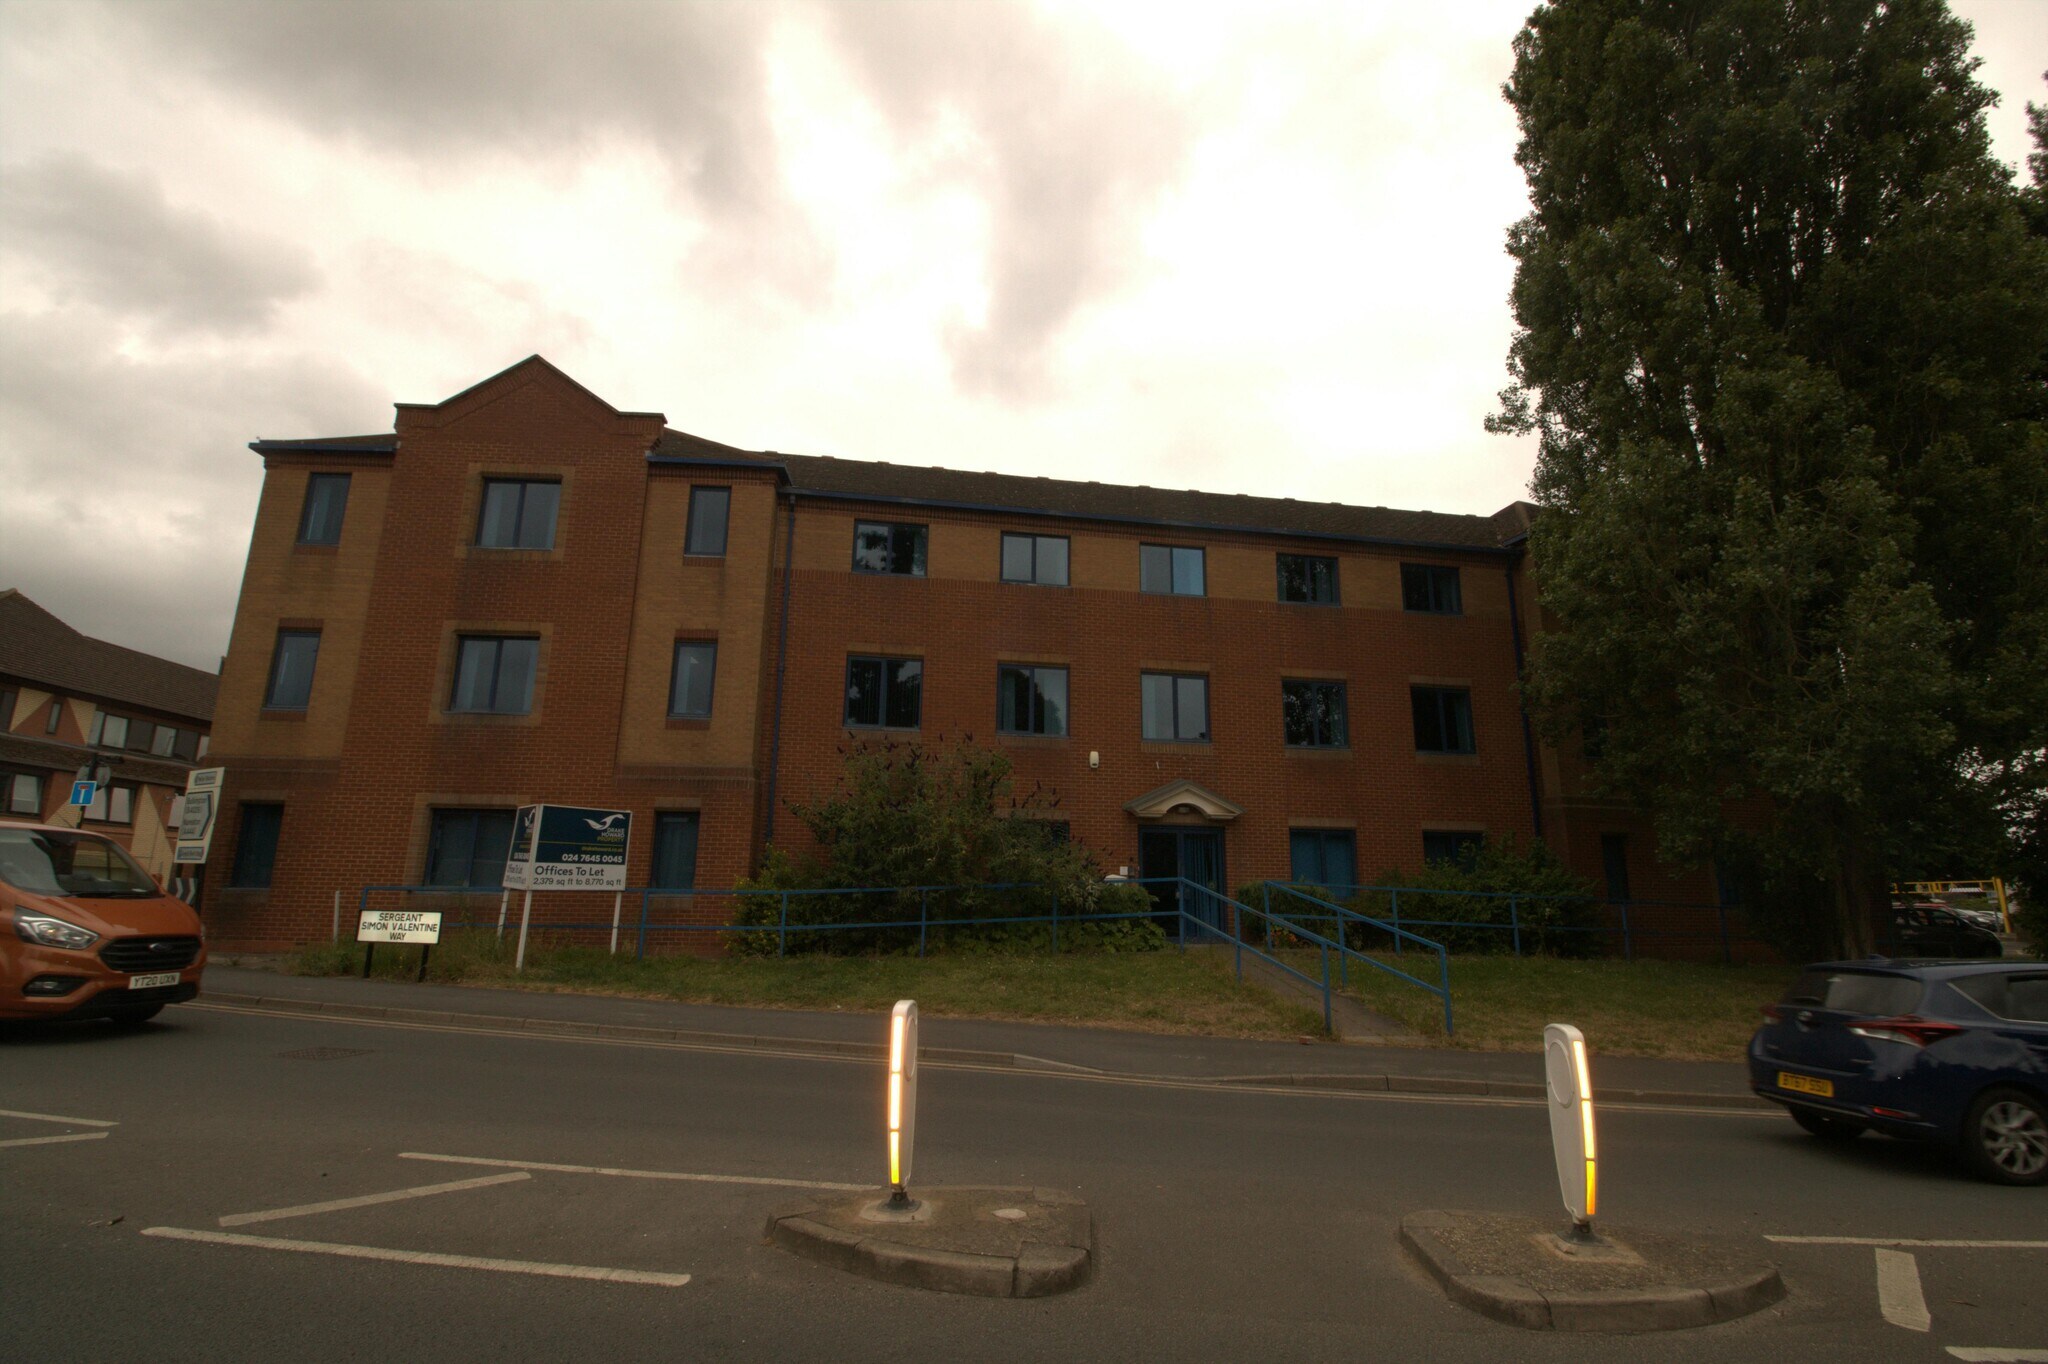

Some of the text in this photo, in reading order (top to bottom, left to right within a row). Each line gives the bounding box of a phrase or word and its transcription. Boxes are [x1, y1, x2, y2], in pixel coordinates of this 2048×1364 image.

[562, 854, 623, 863] 024 7645 0045
[535, 865, 573, 876] Offices
[575, 867, 587, 876] To
[589, 867, 605, 877] Let
[533, 878, 554, 886] 2,379
[576, 878, 584, 886] to
[585, 878, 605, 887] 8,770
[379, 913, 424, 922] SERGEANT
[361, 922, 438, 932] SIMON VALENTINE
[390, 932, 407, 941] WAY
